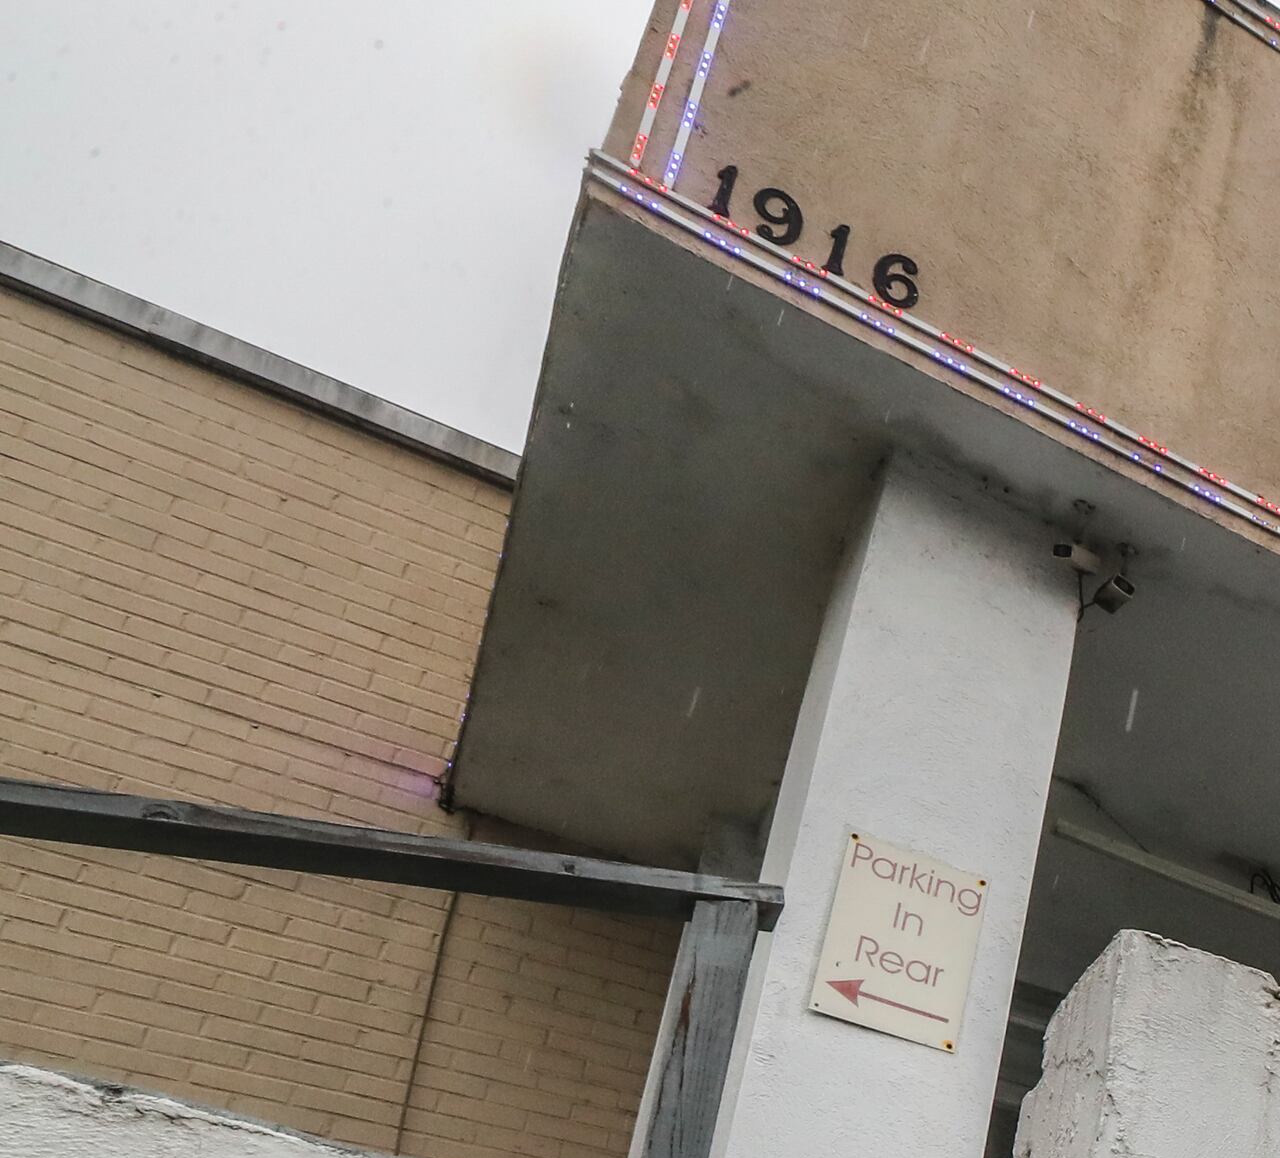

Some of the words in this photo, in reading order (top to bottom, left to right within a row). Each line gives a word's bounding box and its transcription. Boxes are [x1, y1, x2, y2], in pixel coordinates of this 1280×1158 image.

[708, 165, 919, 309] 1916
[851, 842, 982, 917] Parking
[892, 902, 924, 937] In
[854, 935, 945, 988] Rear
